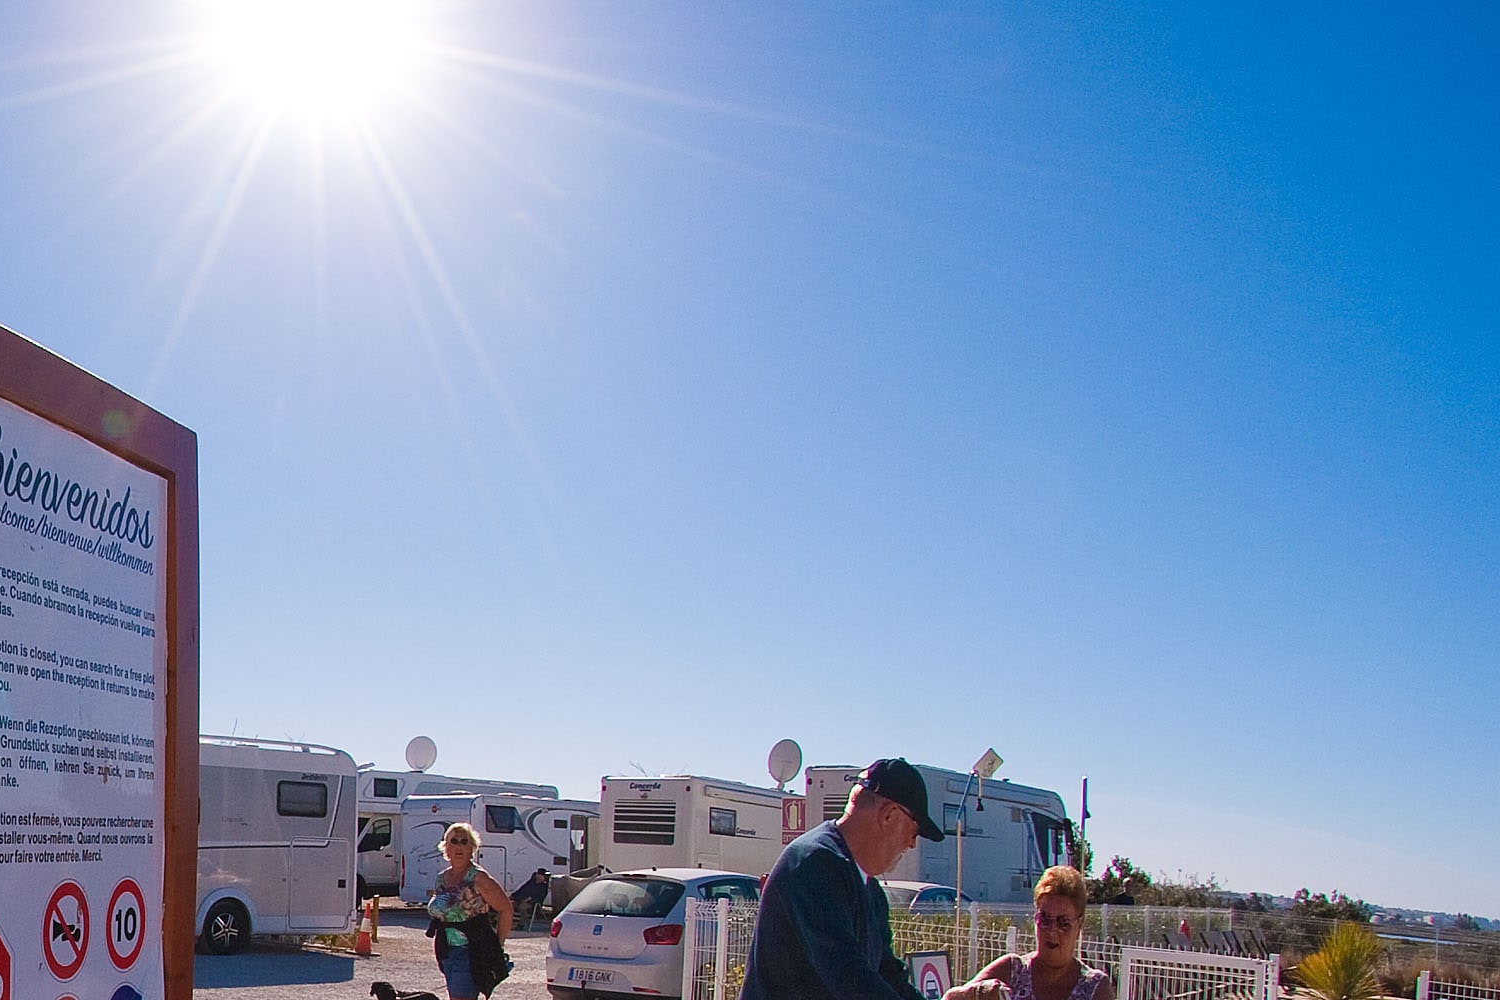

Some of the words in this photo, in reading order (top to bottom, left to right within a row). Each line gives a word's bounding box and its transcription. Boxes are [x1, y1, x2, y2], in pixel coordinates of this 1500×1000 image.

[10, 585, 42, 605] Cuando
[44, 596, 76, 616] abramos
[78, 605, 84, 617] la
[85, 609, 118, 628] recepción
[120, 619, 140, 634] vuelva
[142, 626, 155, 638] para
[42, 579, 59, 593] está
[61, 585, 90, 604] cerrada,
[93, 595, 118, 610] puedes
[120, 600, 142, 617] buscar
[143, 610, 155, 622] una
[20, 643, 28, 657] is
[30, 646, 58, 665] closed,
[60, 655, 74, 668] you
[75, 658, 88, 670] can
[90, 662, 113, 676] search
[114, 664, 124, 678] for
[124, 669, 129, 679] a
[130, 668, 142, 681] free
[16, 664, 29, 676] we
[31, 665, 51, 681] open
[52, 668, 64, 682] the
[65, 674, 99, 689] reception
[100, 678, 105, 691] it
[106, 681, 129, 696] returns
[131, 686, 137, 697] to
[138, 688, 155, 701] make
[0, 715, 23, 732] Wenn
[25, 719, 37, 733] die
[39, 720, 76, 739] Rezeption
[78, 727, 120, 743] geschlossen
[0, 734, 50, 753] Grundstück
[52, 742, 79, 756] suchen
[81, 745, 95, 757] und
[96, 747, 117, 760] selbst
[19, 756, 49, 773] öffnen,
[54, 759, 80, 774] kehren
[83, 761, 94, 775] Sie
[125, 768, 135, 778] um
[138, 767, 154, 780] Ihren
[629, 782, 661, 790] Concorde
[18, 813, 31, 826] est
[32, 812, 62, 827] fermée,
[62, 816, 80, 827] vous
[81, 817, 106, 830] pouvez
[107, 816, 141, 828] rechercher
[141, 819, 154, 829] une
[27, 831, 75, 845] vous-même.
[77, 831, 100, 845] Quand
[102, 834, 119, 845] nous
[120, 834, 146, 845] ouvrons
[147, 833, 153, 845] la
[14, 849, 33, 863] faire
[34, 849, 55, 863] votre
[55, 849, 80, 862] entrée.
[82, 849, 103, 862] Merci.
[115, 907, 137, 942] 10
[575, 970, 594, 980] 1816
[595, 971, 612, 982] GNK
